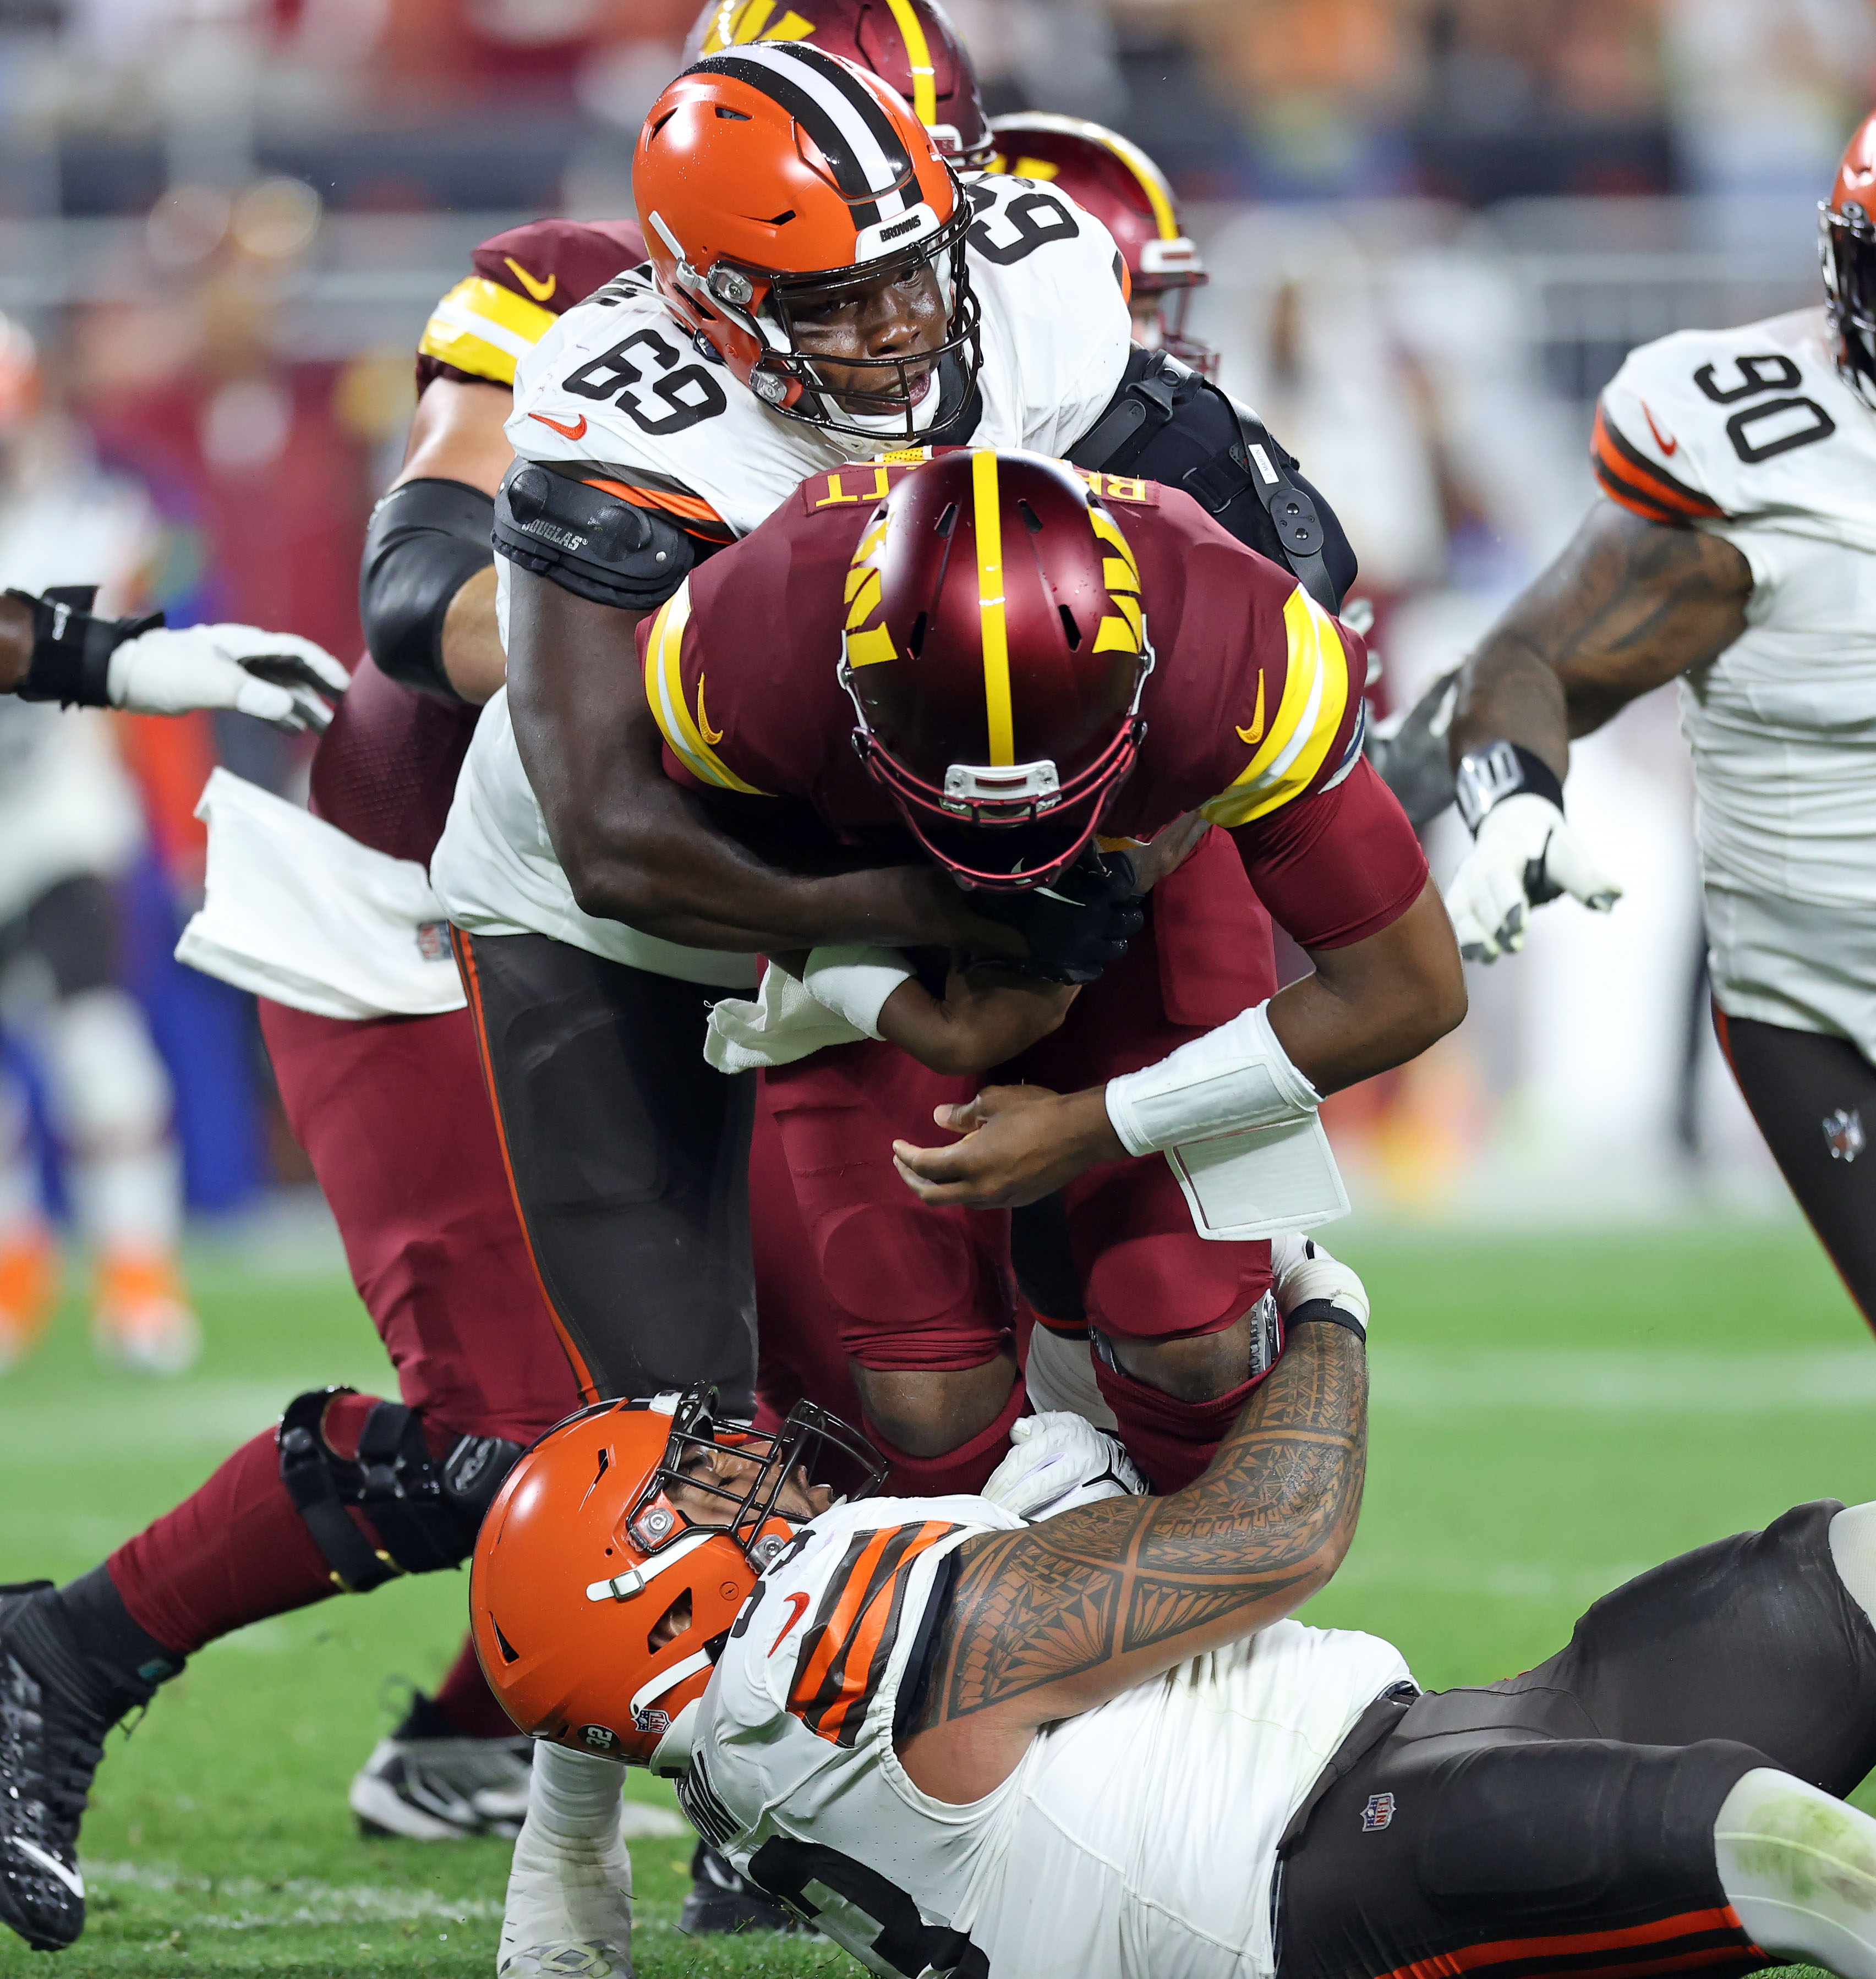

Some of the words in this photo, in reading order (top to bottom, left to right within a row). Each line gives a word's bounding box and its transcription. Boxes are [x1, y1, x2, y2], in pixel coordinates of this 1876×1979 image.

[879, 215, 921, 243] BROWNS
[562, 329, 726, 435] 69
[1693, 355, 1835, 463] 90
[650, 1713, 666, 1731] NFL
[586, 1726, 613, 1750] 32
[1376, 1798, 1388, 1824] NFL
